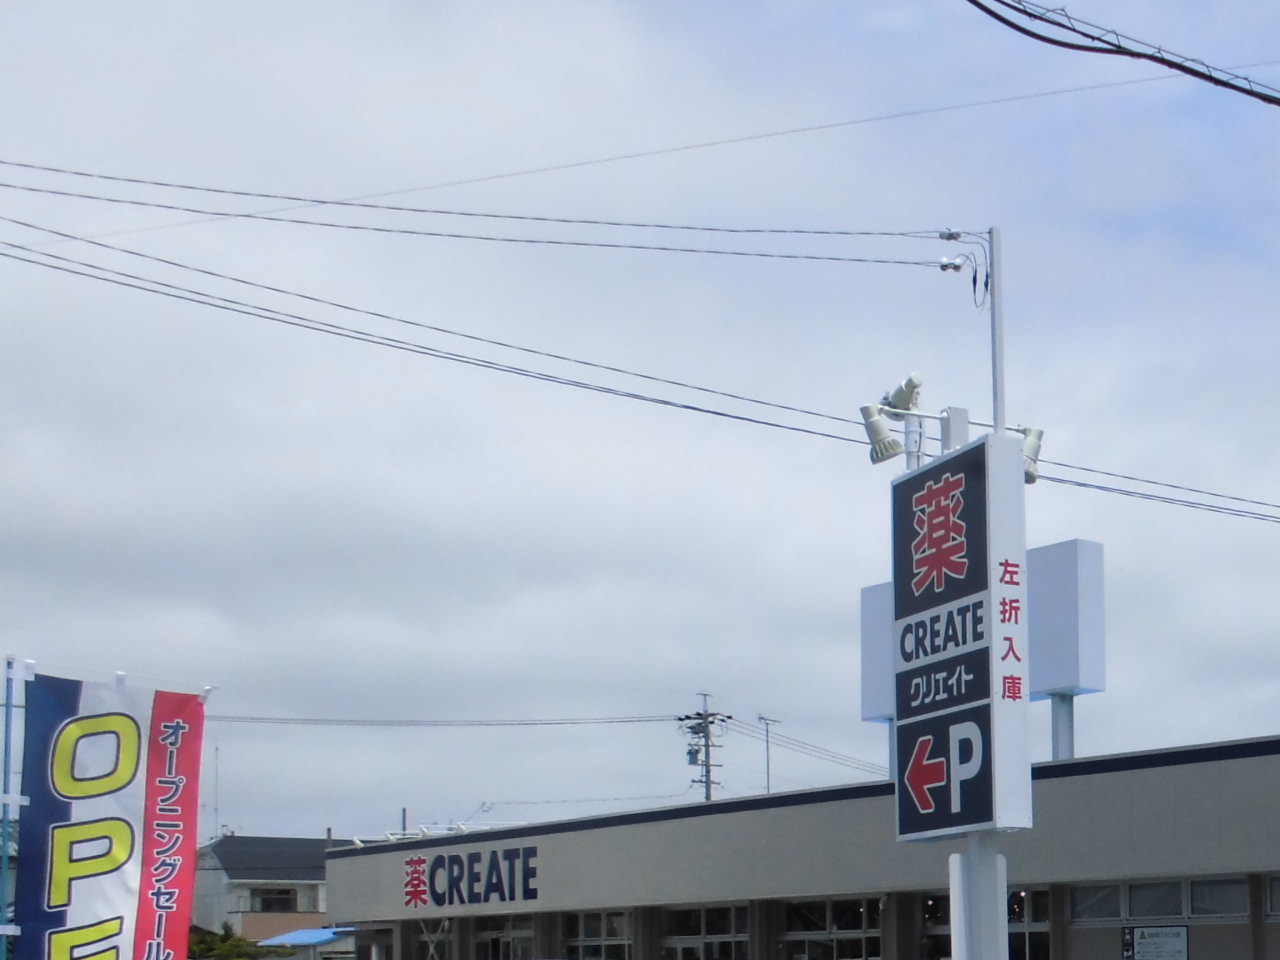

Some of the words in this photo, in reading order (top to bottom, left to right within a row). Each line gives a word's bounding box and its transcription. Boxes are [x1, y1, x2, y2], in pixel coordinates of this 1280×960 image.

[912, 473, 968, 597] 薬
[900, 600, 985, 663] CREATE
[999, 559, 1022, 702] 左折入庫
[910, 664, 974, 707] クリエイト
[949, 720, 983, 814] P
[430, 846, 538, 907] CREATE
